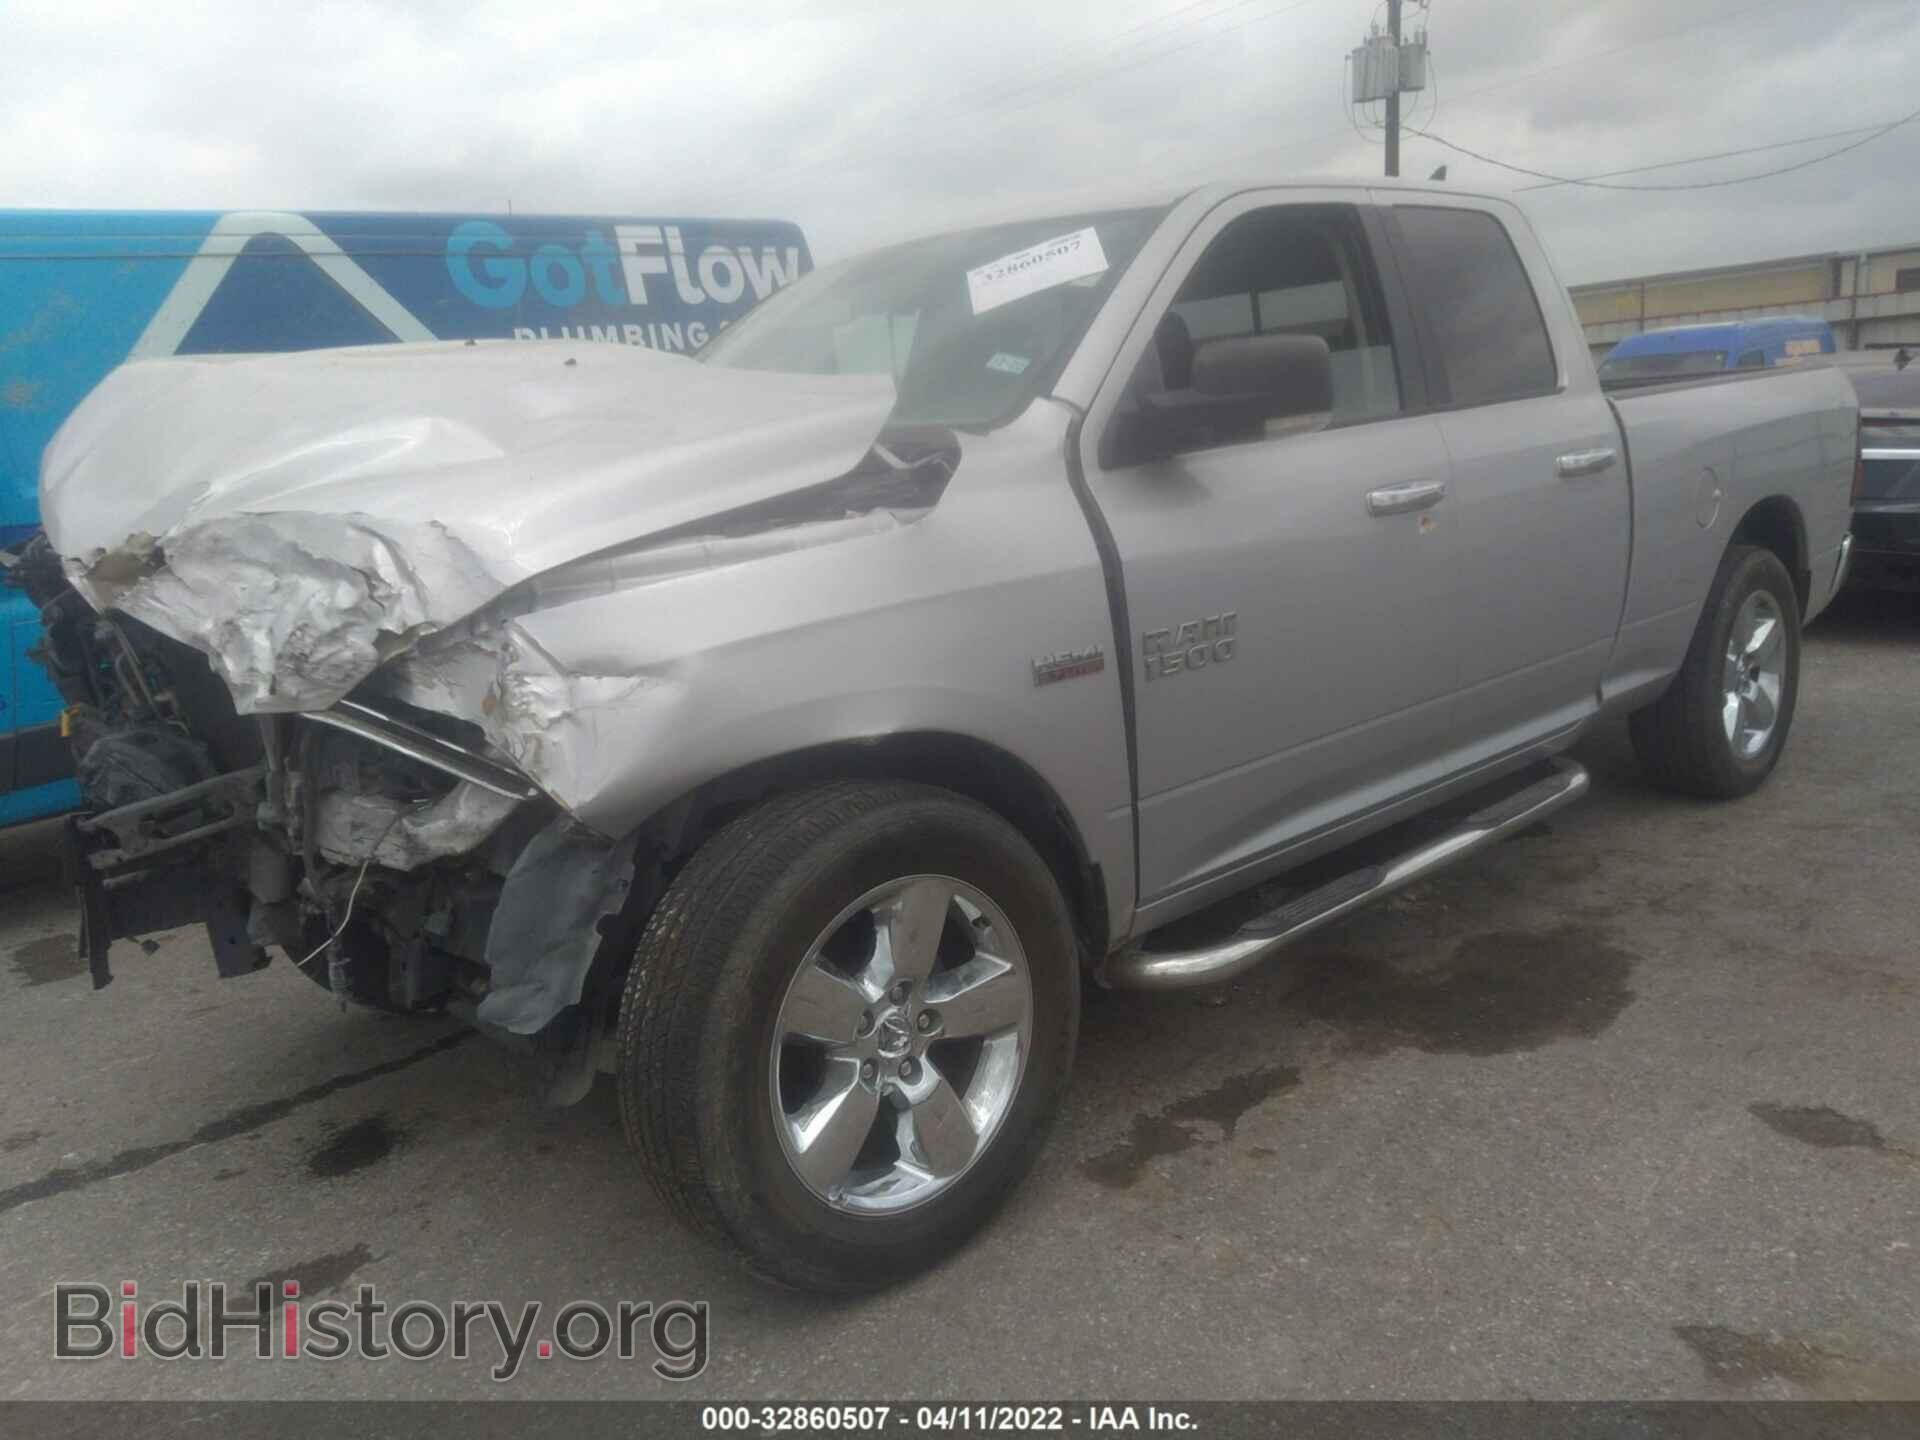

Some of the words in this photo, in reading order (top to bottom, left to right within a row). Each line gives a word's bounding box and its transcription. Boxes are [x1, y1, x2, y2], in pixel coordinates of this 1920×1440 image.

[445, 220, 800, 309] GotFlow
[1142, 609, 1238, 654] RAM
[1144, 637, 1238, 682] 1500
